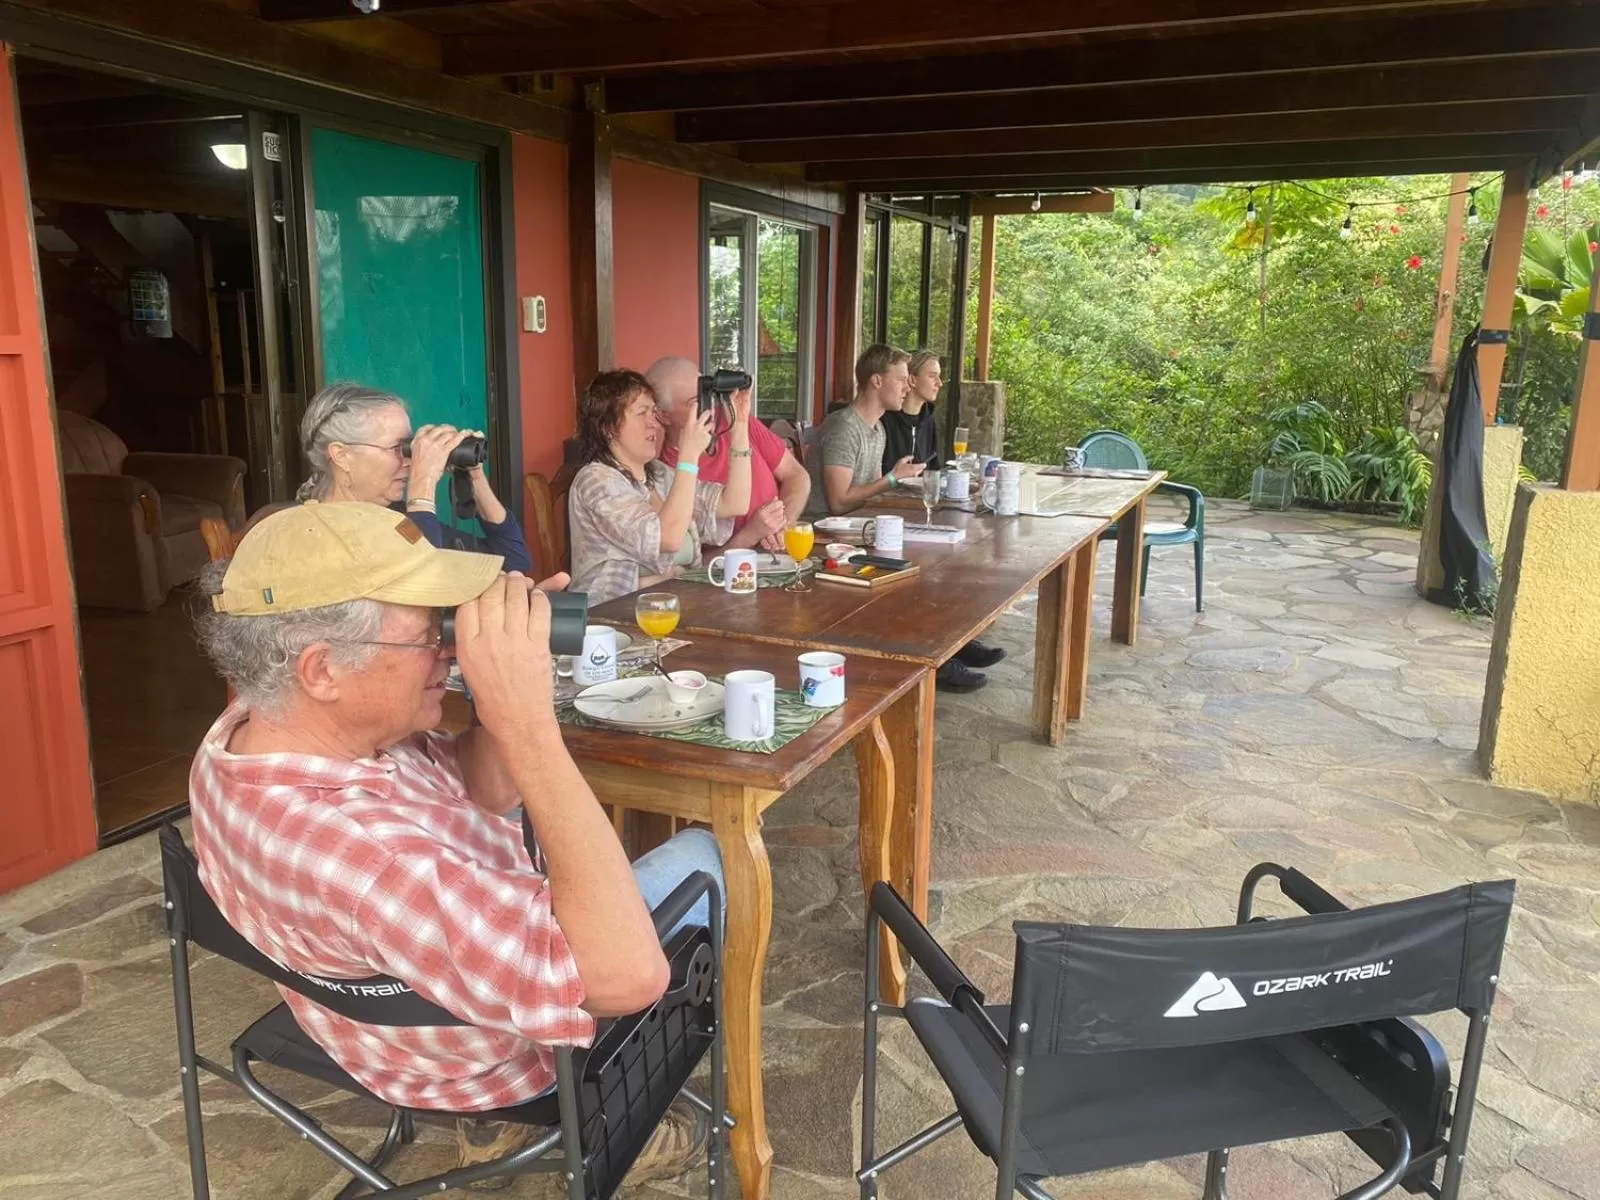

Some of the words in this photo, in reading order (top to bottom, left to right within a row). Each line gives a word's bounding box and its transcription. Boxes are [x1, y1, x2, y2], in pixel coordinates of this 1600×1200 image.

[345, 982, 413, 997] TRAIL
[1253, 972, 1332, 996] OZARK
[1333, 961, 1391, 984] TRAIL
